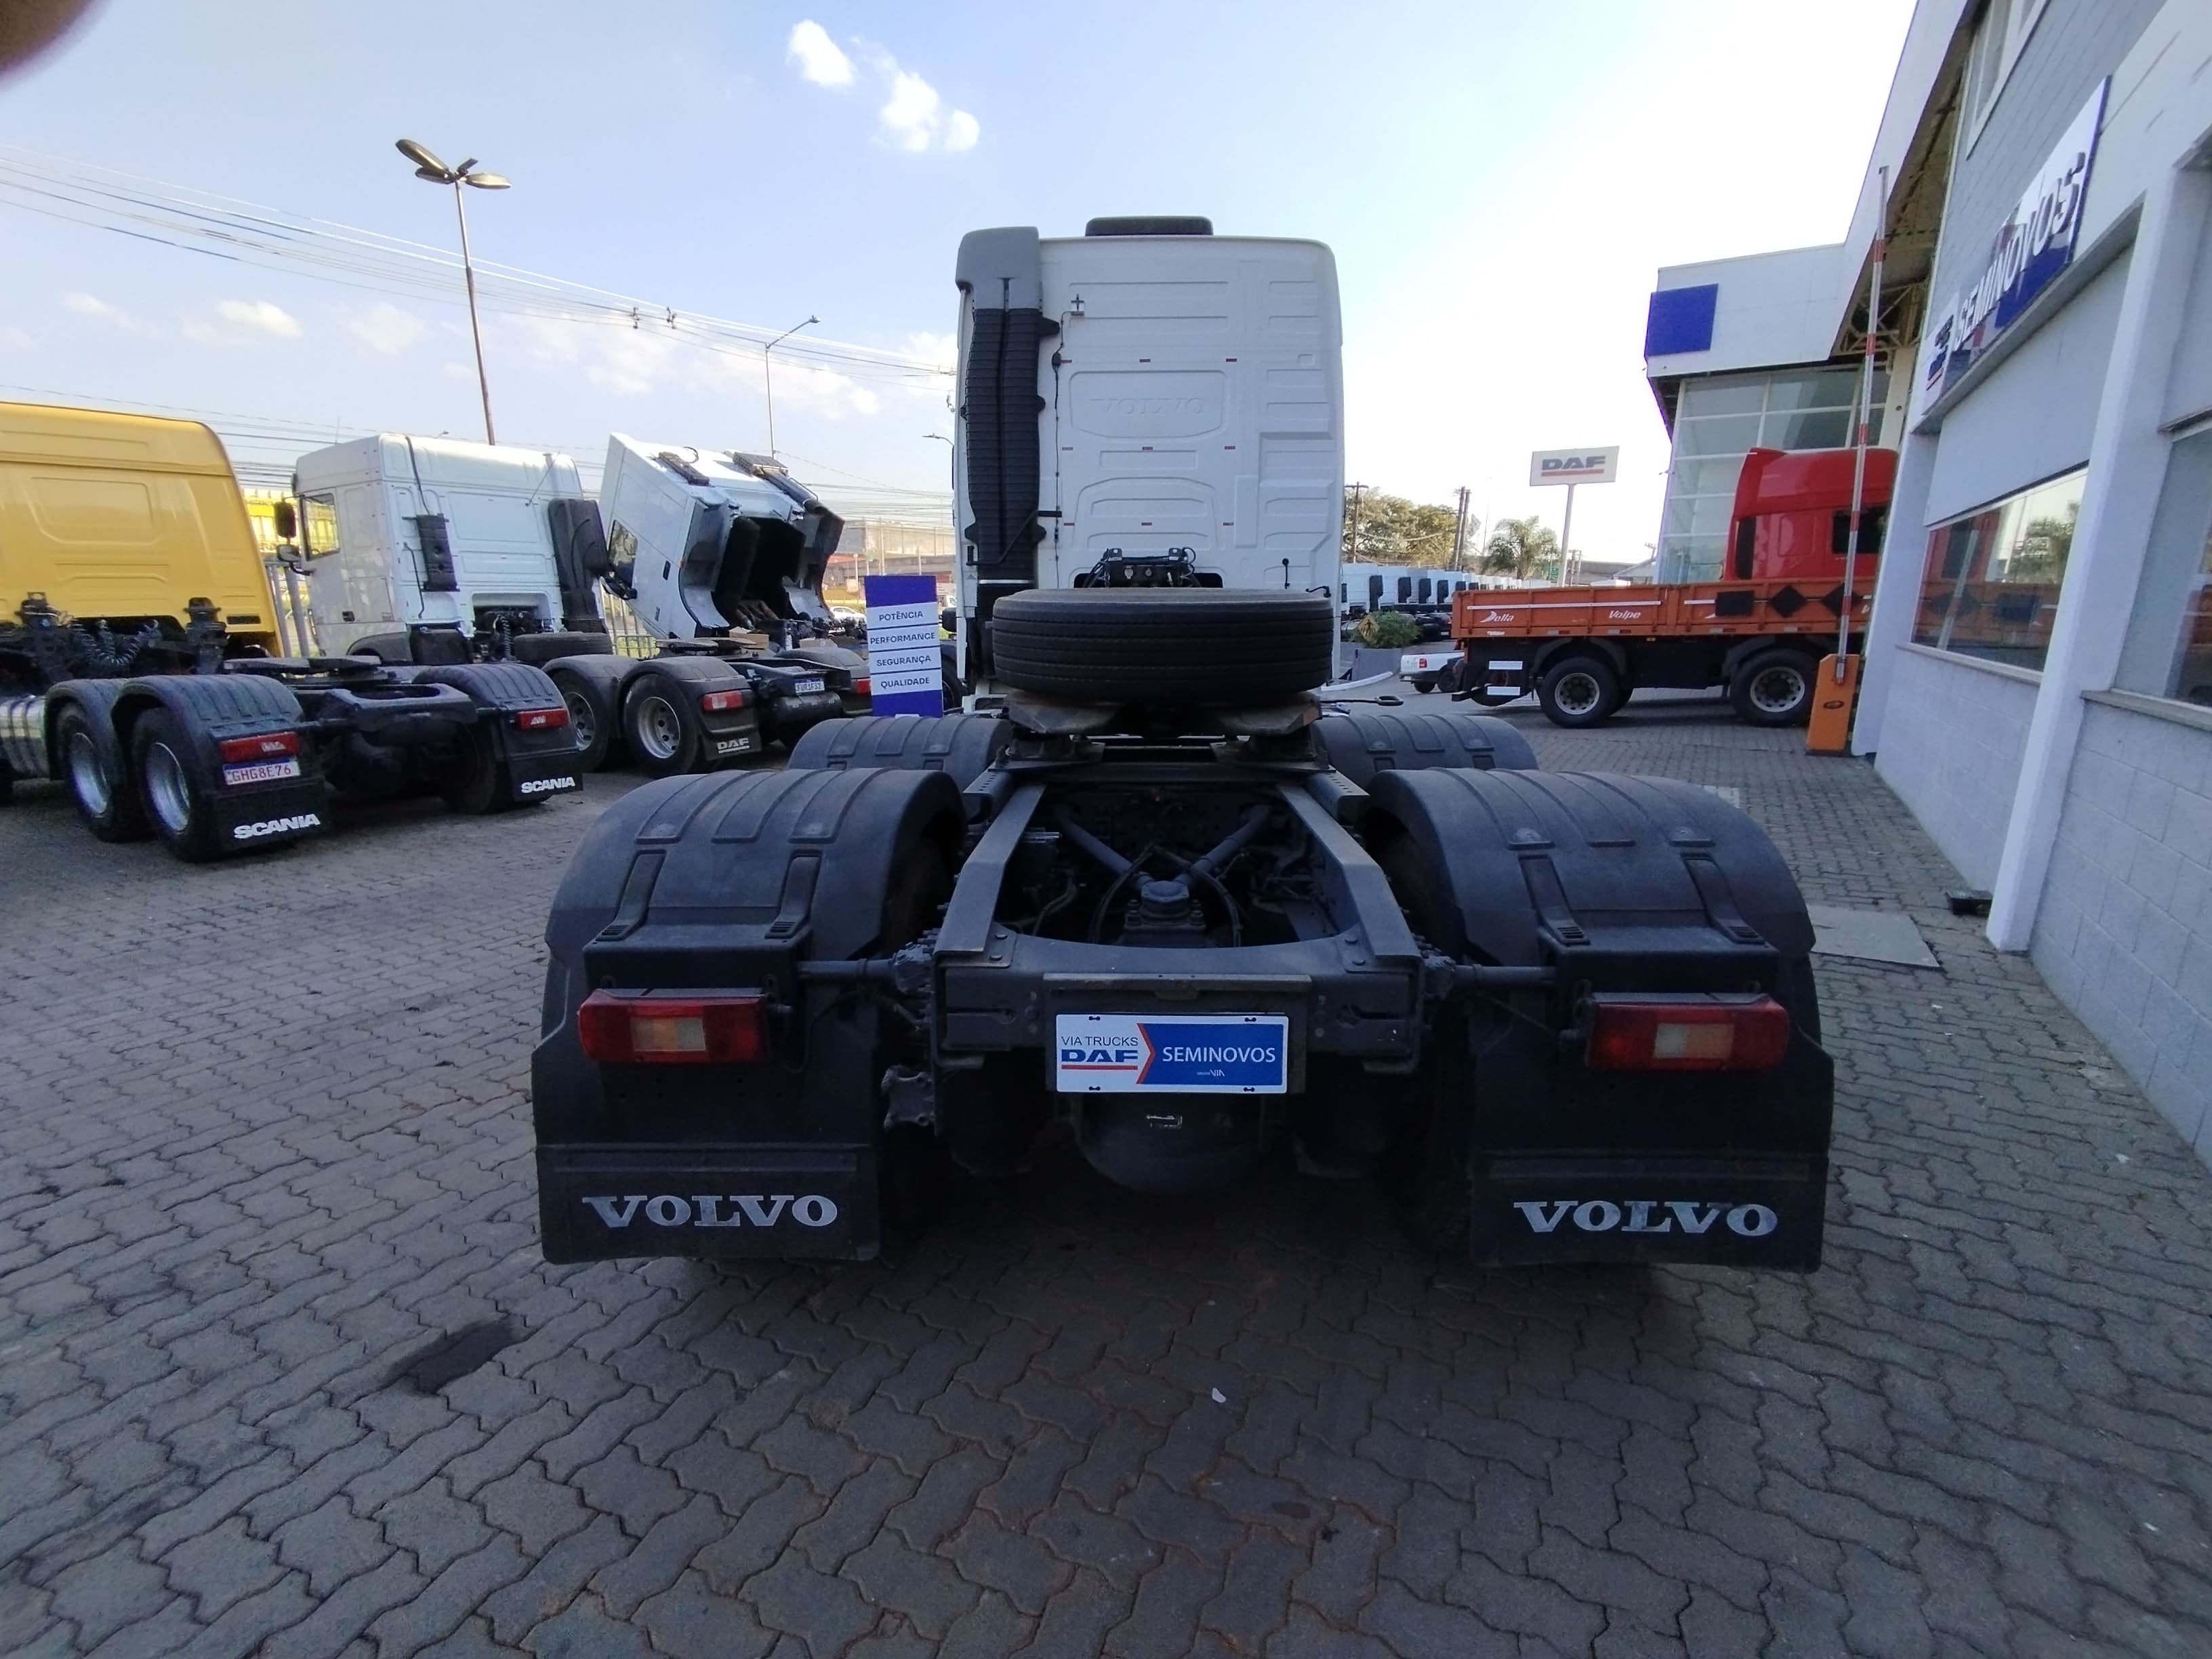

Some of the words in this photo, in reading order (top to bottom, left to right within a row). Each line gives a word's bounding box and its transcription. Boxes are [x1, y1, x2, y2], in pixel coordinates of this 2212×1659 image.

[1953, 152, 2086, 353] SEMINOVOS
[1090, 397, 1204, 414] VOLVO
[1542, 455, 1606, 470] DAF
[879, 611, 924, 621] POTÊNCIA
[1609, 610, 1641, 620] Volpe
[870, 632, 936, 644] PERFORMANCE
[876, 655, 932, 666] SEGURANÇA
[881, 677, 930, 689] QUALIDADE
[717, 737, 750, 750] DAF
[232, 764, 291, 782] GHG8E76
[521, 777, 575, 794] SCANIA
[234, 813, 321, 840] SCANIA
[1061, 1036, 1082, 1046] VIA
[1085, 1036, 1139, 1046] TRUCKS
[1061, 1049, 1139, 1062] DAF
[1162, 1046, 1276, 1062] SEMINOVOS
[582, 1195, 838, 1228] VOLVO
[1513, 1200, 1778, 1237] VOLVO
